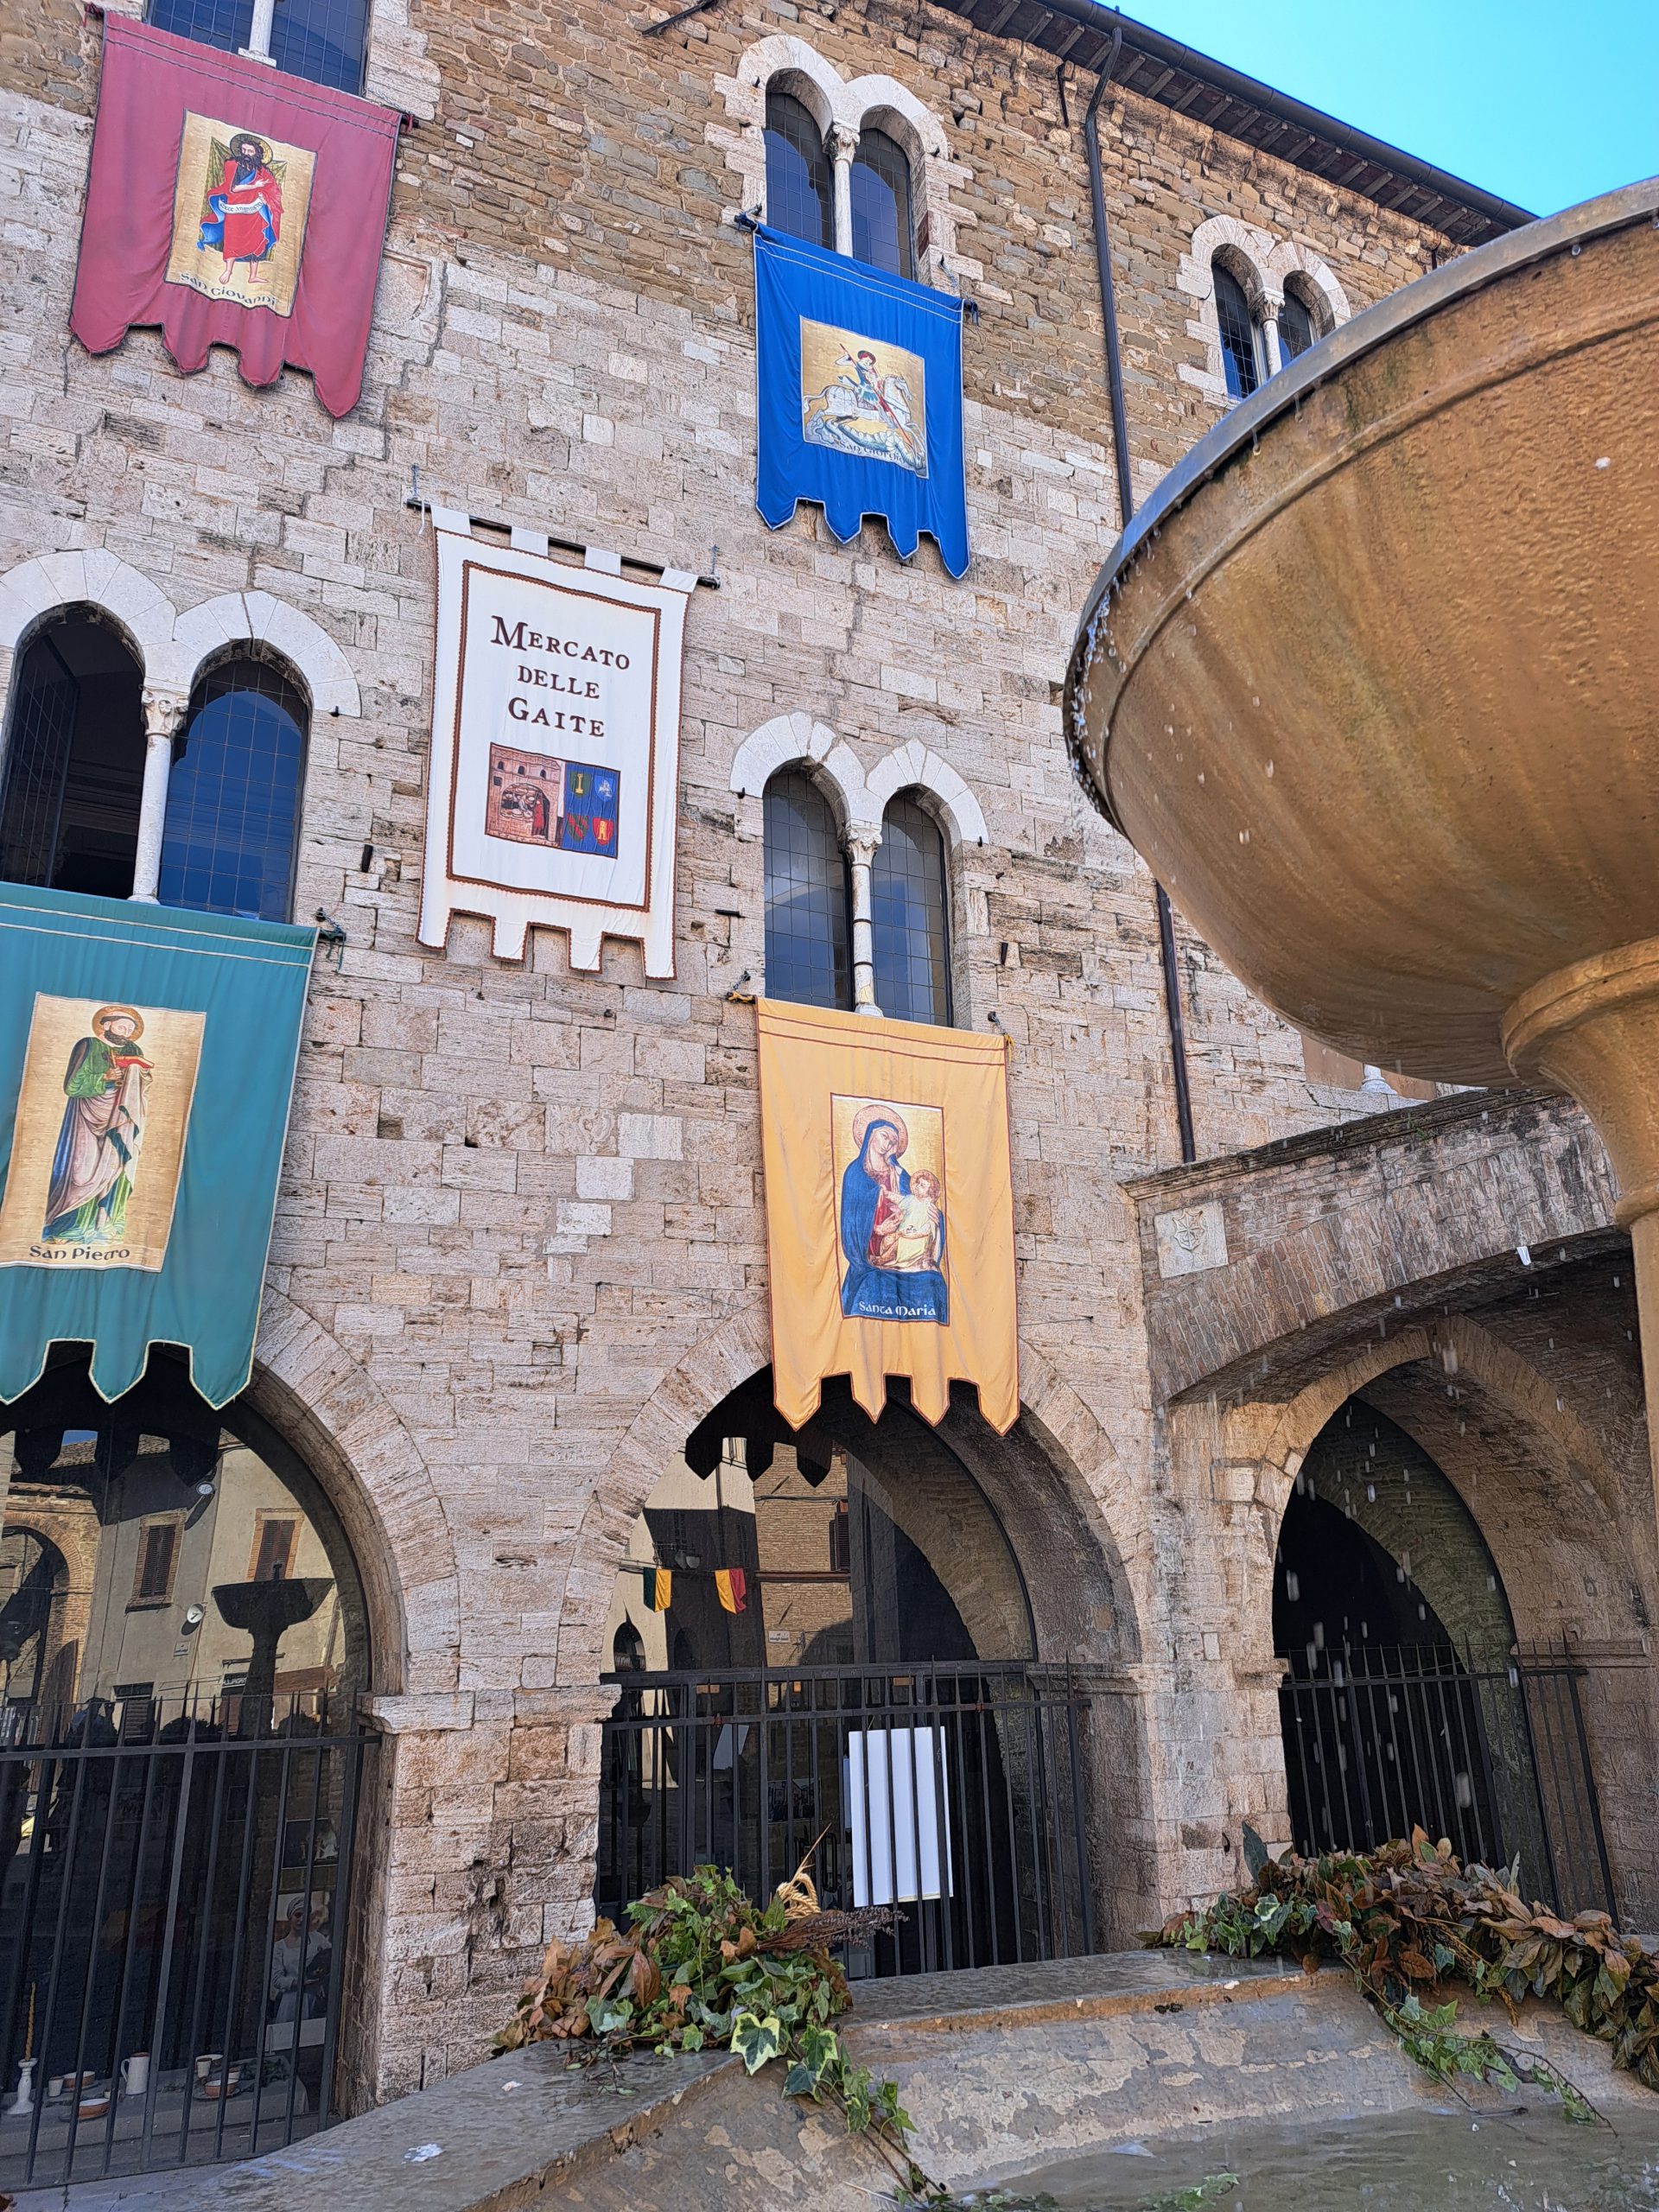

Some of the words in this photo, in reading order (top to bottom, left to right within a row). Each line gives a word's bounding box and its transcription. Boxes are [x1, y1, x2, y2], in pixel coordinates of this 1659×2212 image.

[181, 273, 207, 289] San
[211, 286, 276, 306] Giovanni
[840, 441, 861, 454] San
[490, 615, 630, 670] MERCATO
[517, 664, 600, 699] DELLE
[508, 696, 605, 737] GAITE
[29, 1245, 67, 1260] San
[72, 1246, 130, 1261] Pietro
[859, 1301, 893, 1314] Santa
[895, 1304, 937, 1316] Maria
